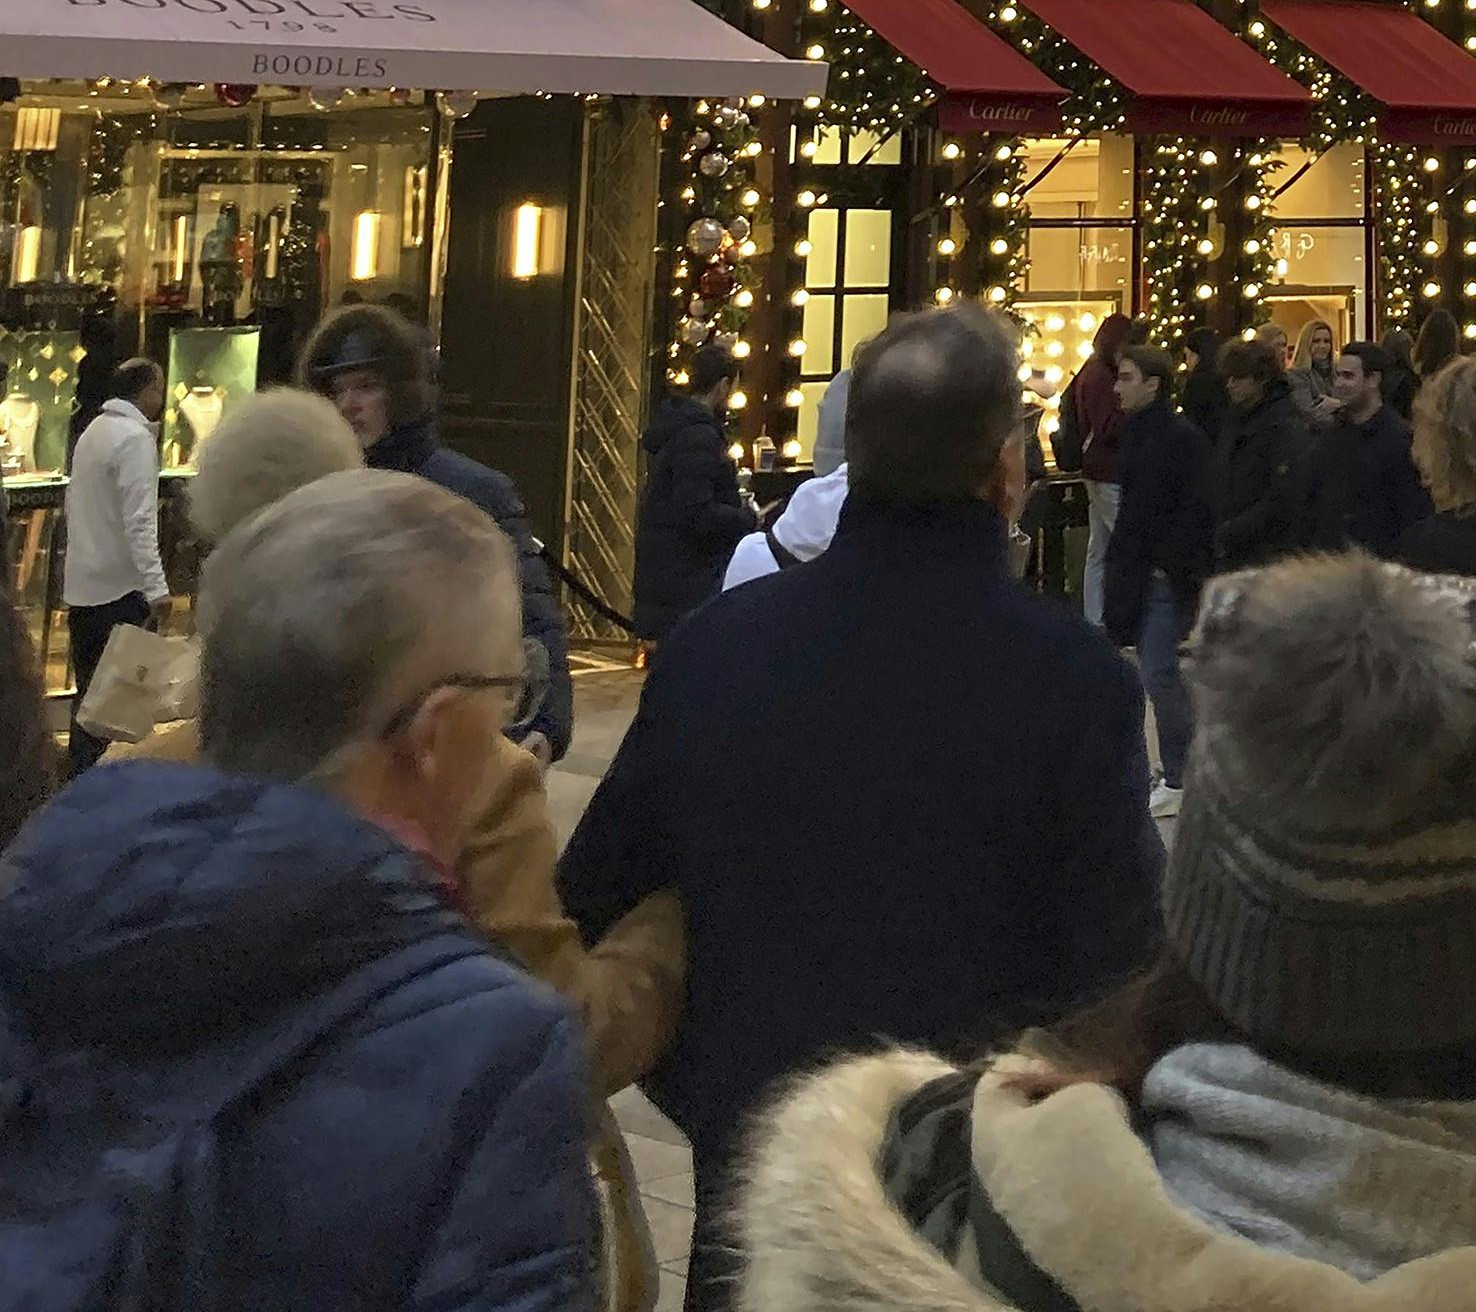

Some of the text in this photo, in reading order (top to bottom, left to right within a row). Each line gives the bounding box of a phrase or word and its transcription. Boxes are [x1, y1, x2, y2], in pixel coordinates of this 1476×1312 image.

[226, 20, 338, 34] 1798
[252, 54, 388, 78] BOODLES
[969, 98, 1035, 122] Cartier
[1190, 103, 1251, 125] Cartier
